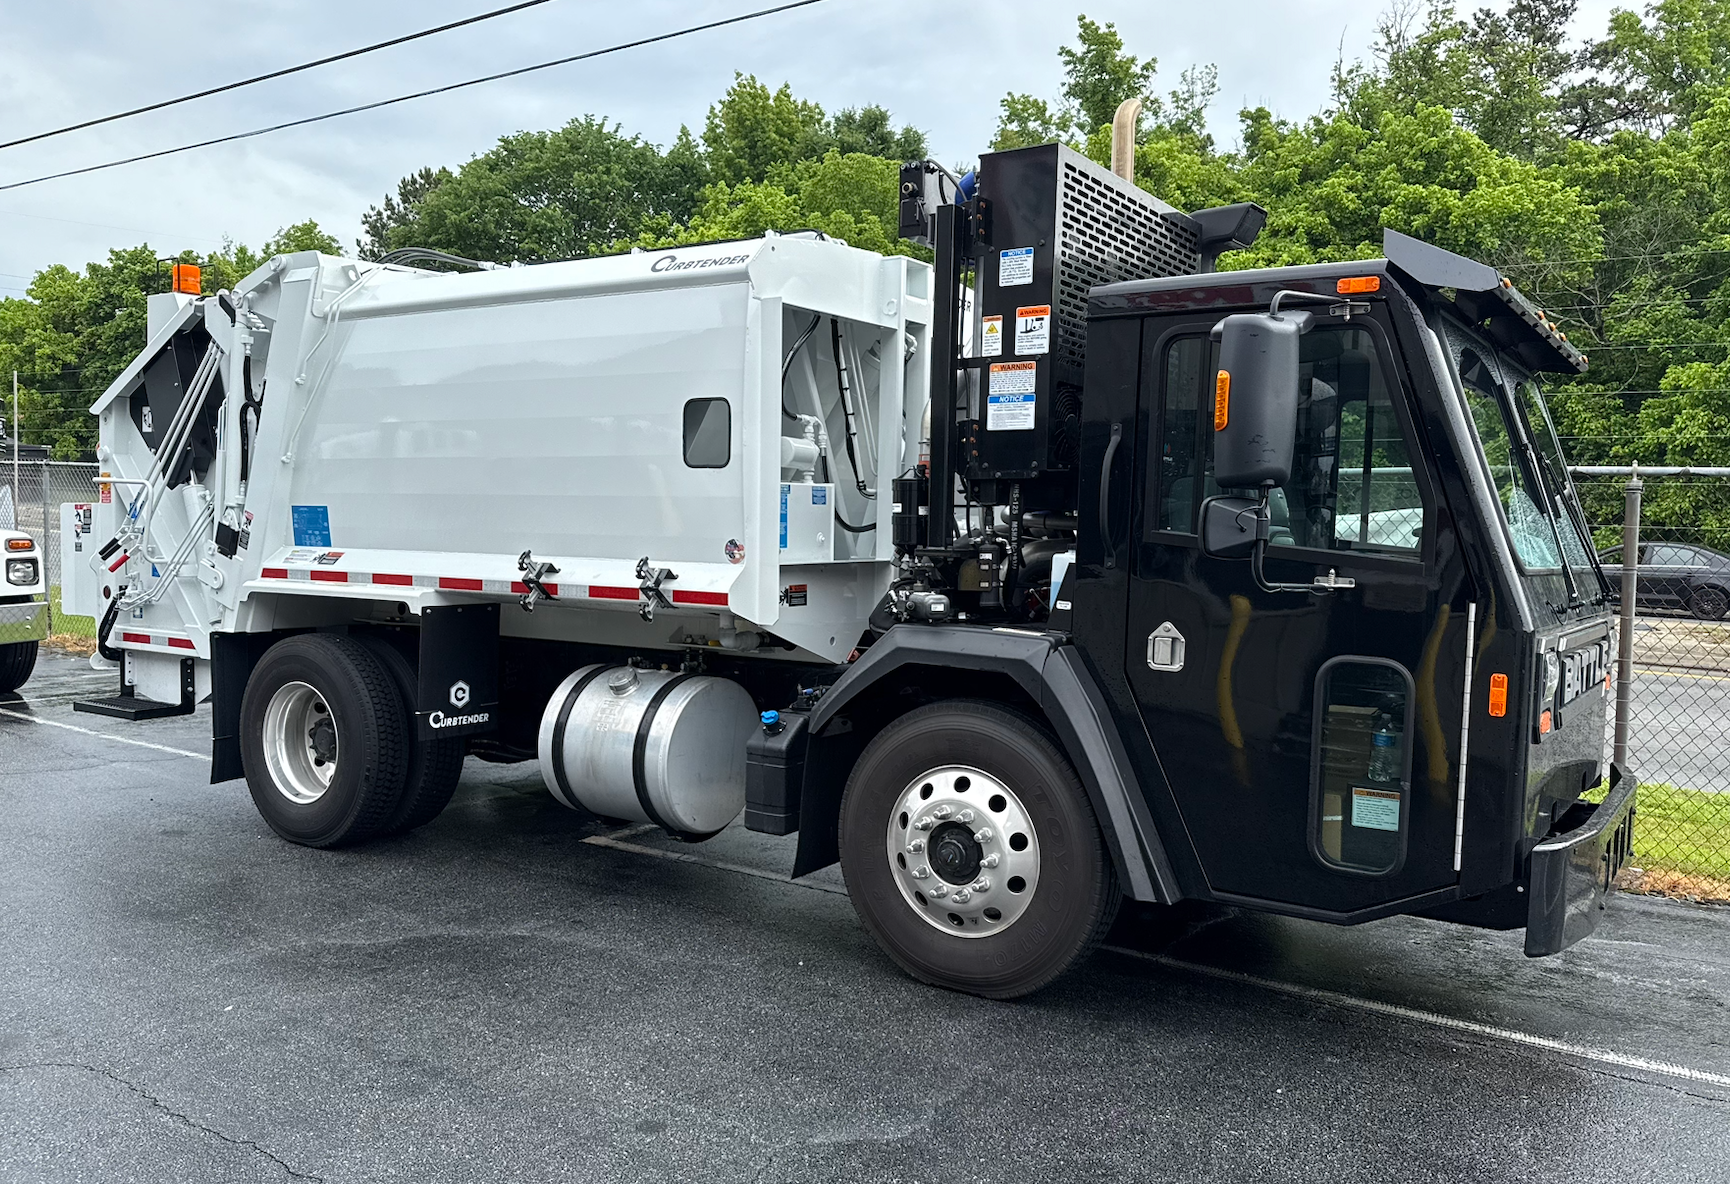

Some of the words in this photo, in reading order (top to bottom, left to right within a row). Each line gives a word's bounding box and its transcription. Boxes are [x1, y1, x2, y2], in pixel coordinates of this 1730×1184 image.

[650, 254, 750, 273] CURBTENDER
[1023, 308, 1047, 316] WARNING
[1000, 362, 1034, 372] WARNING
[998, 395, 1025, 403] NOTICE
[429, 710, 490, 729] CURBTENDER
[1366, 790, 1396, 799] WARNING
[1033, 783, 1071, 913] TOYO
[993, 919, 1049, 968] M170
